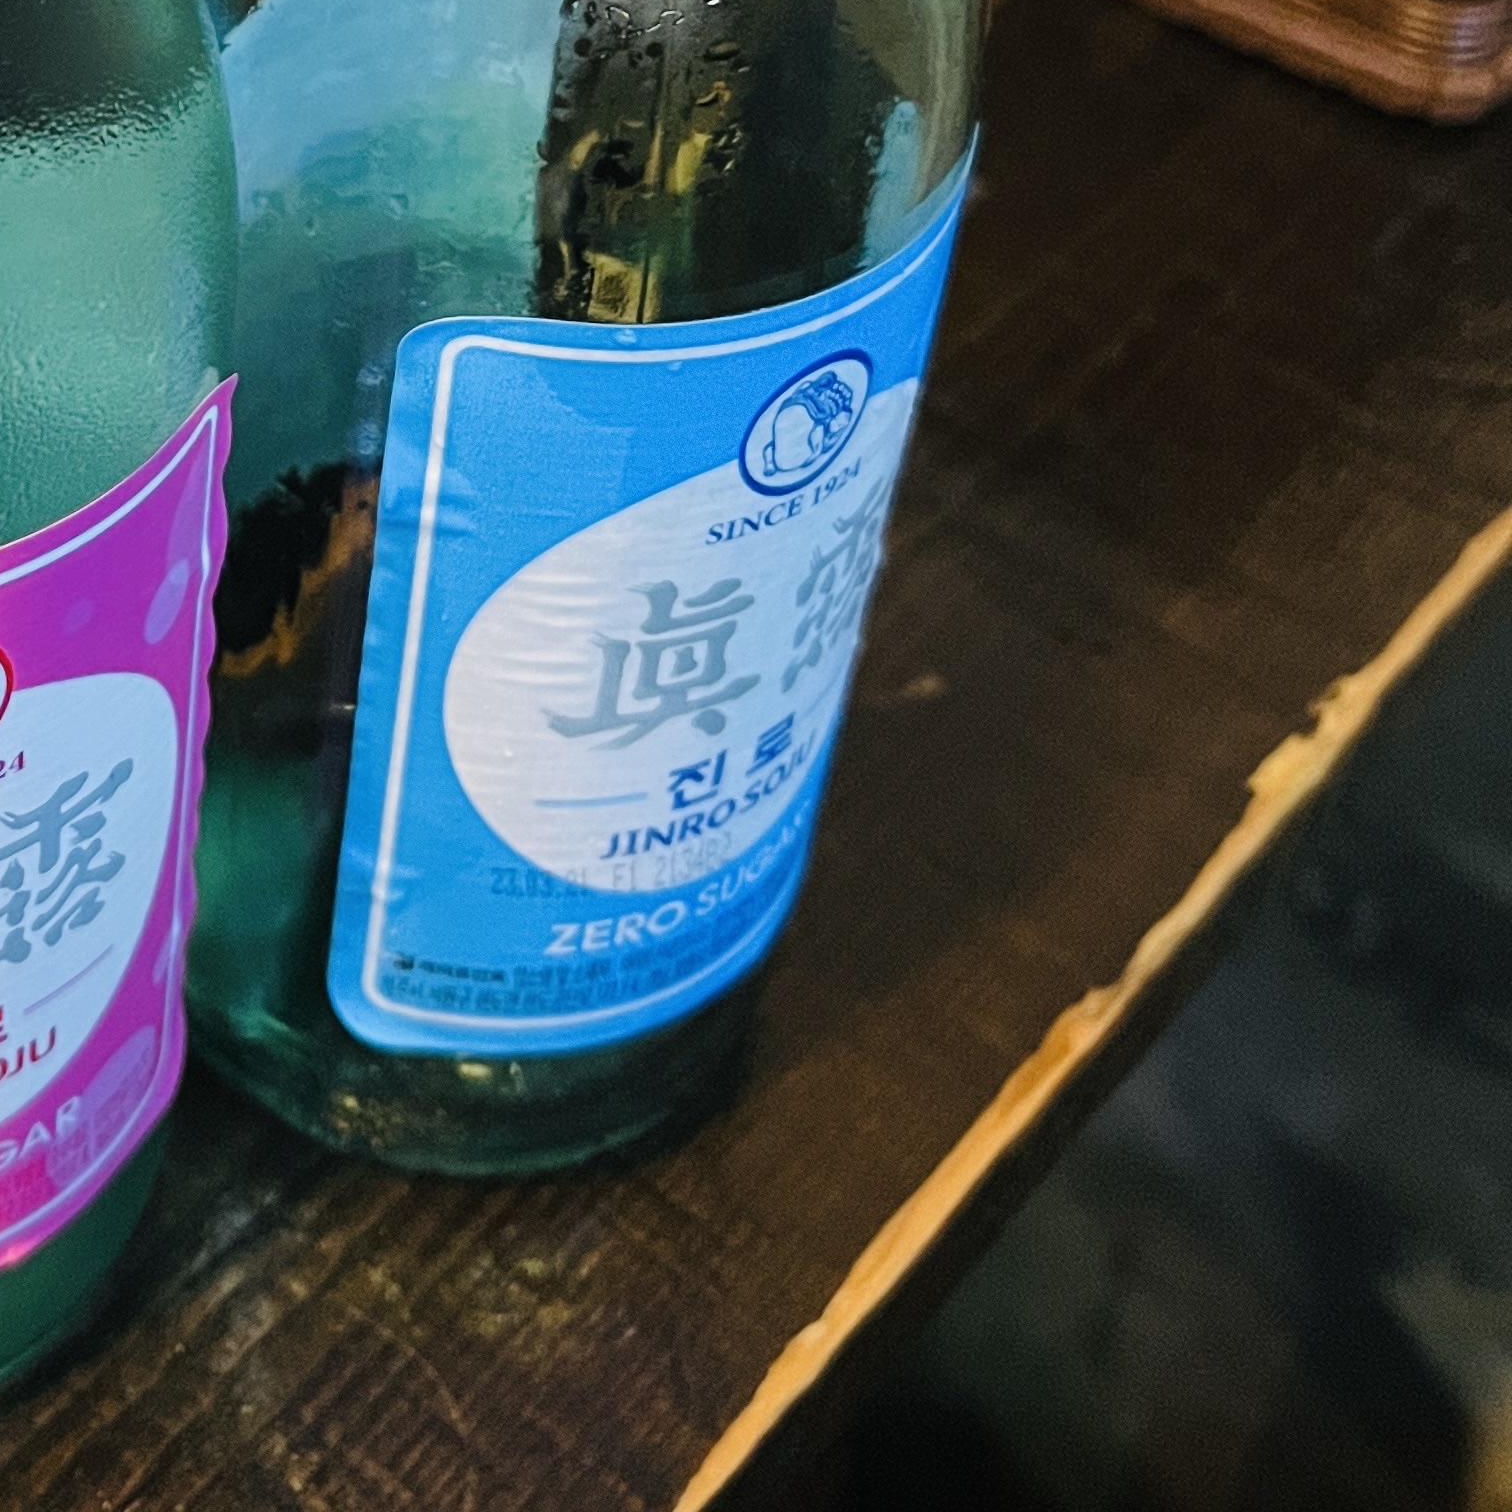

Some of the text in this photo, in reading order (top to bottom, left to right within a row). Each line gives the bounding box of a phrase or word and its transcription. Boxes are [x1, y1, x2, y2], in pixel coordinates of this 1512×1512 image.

[705, 456, 863, 545] SINCE 1924
[600, 727, 818, 860] JINRO SOJU
[544, 899, 688, 957] ZERO
